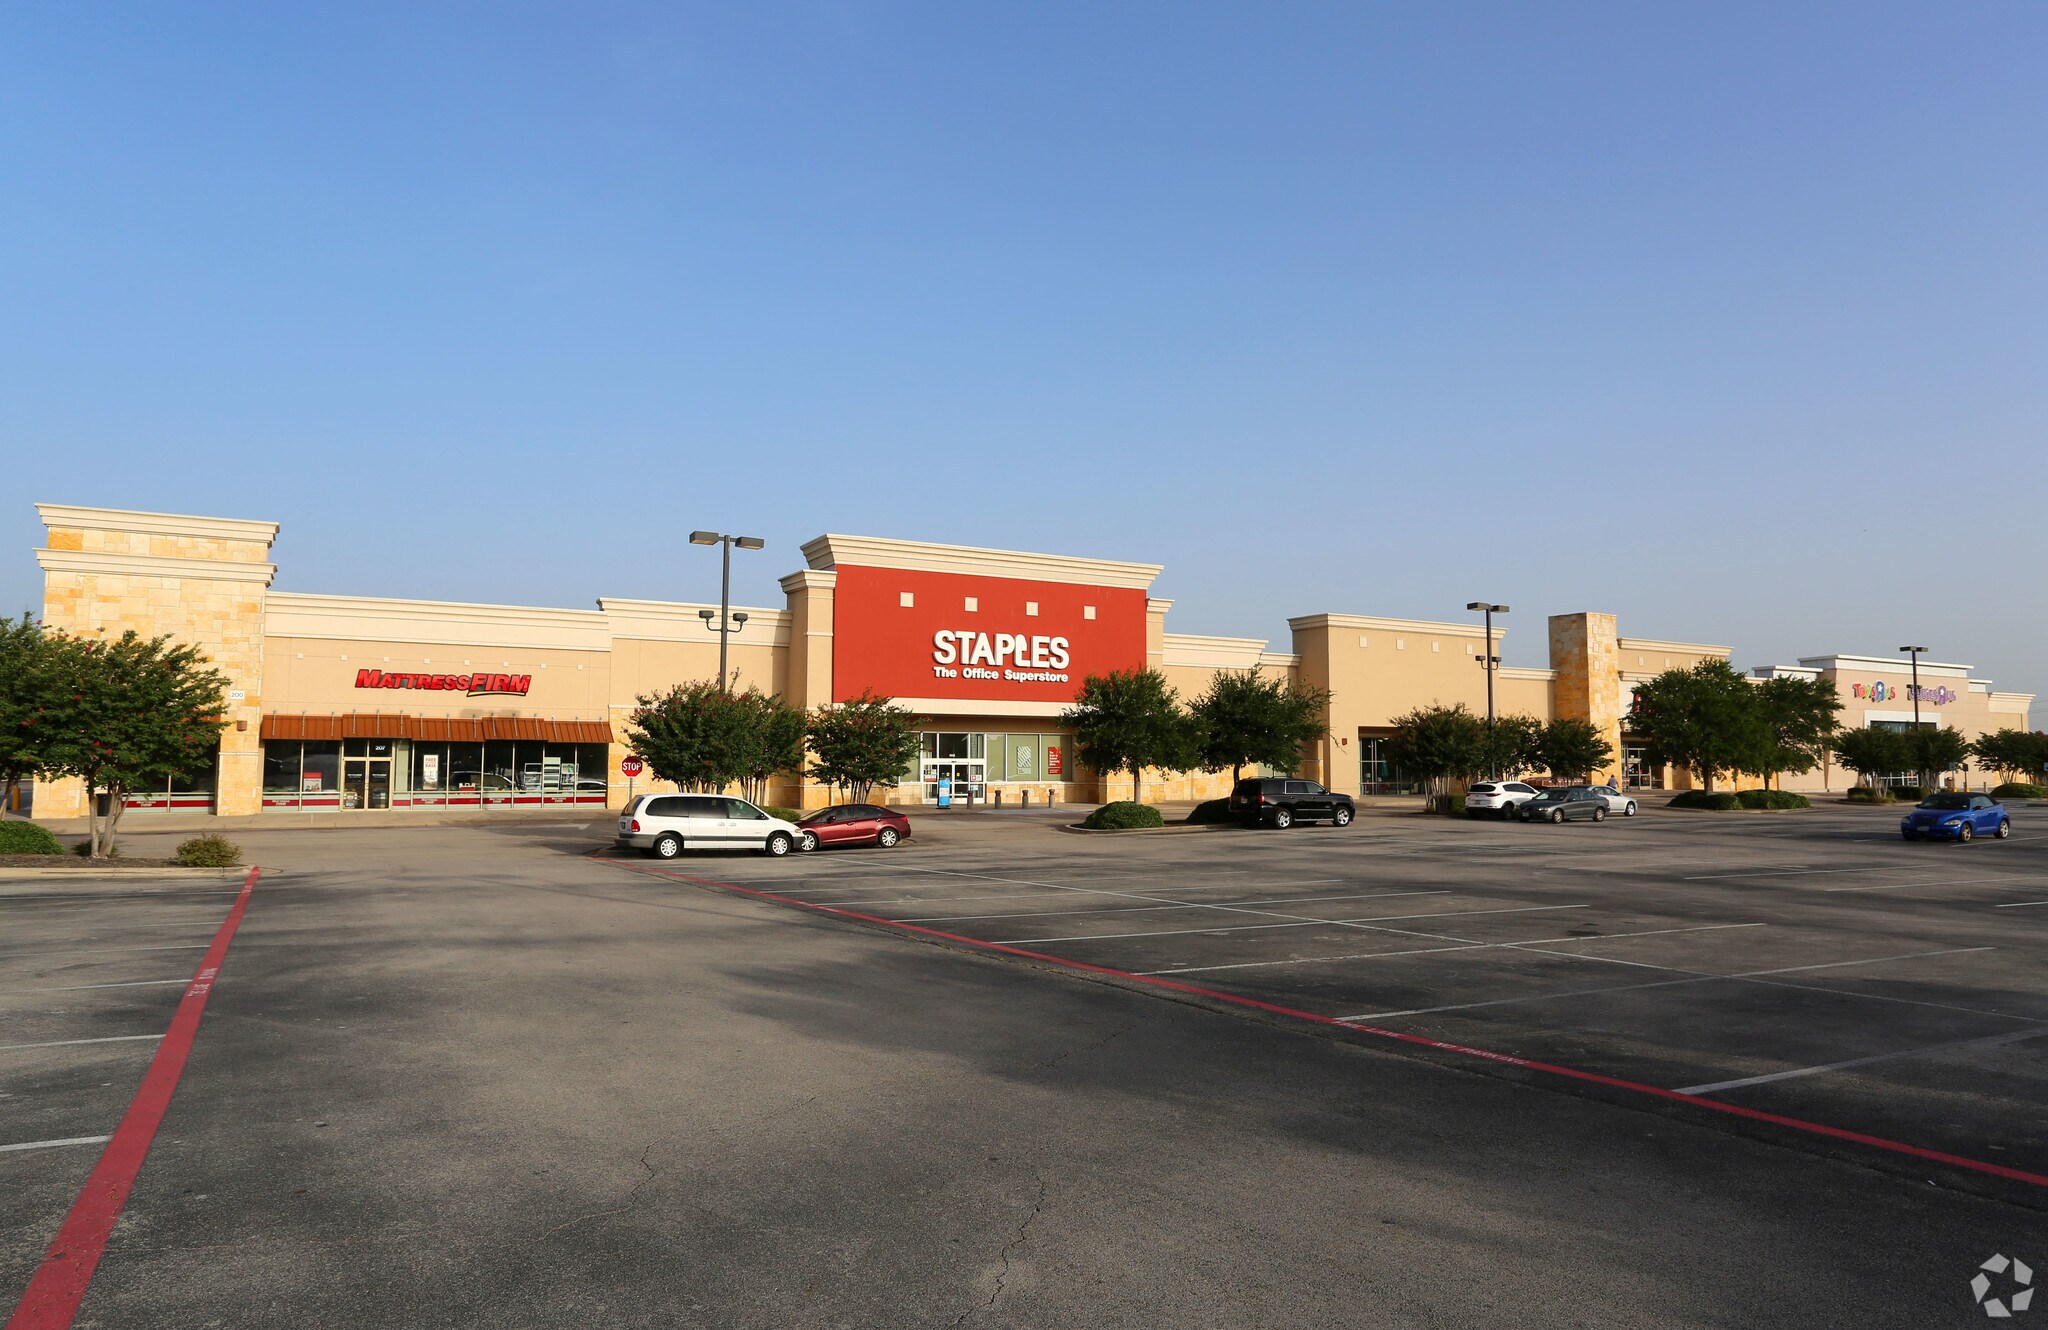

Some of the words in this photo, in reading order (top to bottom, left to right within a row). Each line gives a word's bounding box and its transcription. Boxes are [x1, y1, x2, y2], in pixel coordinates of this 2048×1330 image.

[932, 629, 1070, 669] STAPLES
[933, 666, 957, 678] The
[962, 667, 999, 680] Office
[1004, 669, 1069, 682] Superstore
[622, 761, 642, 771] STOP
